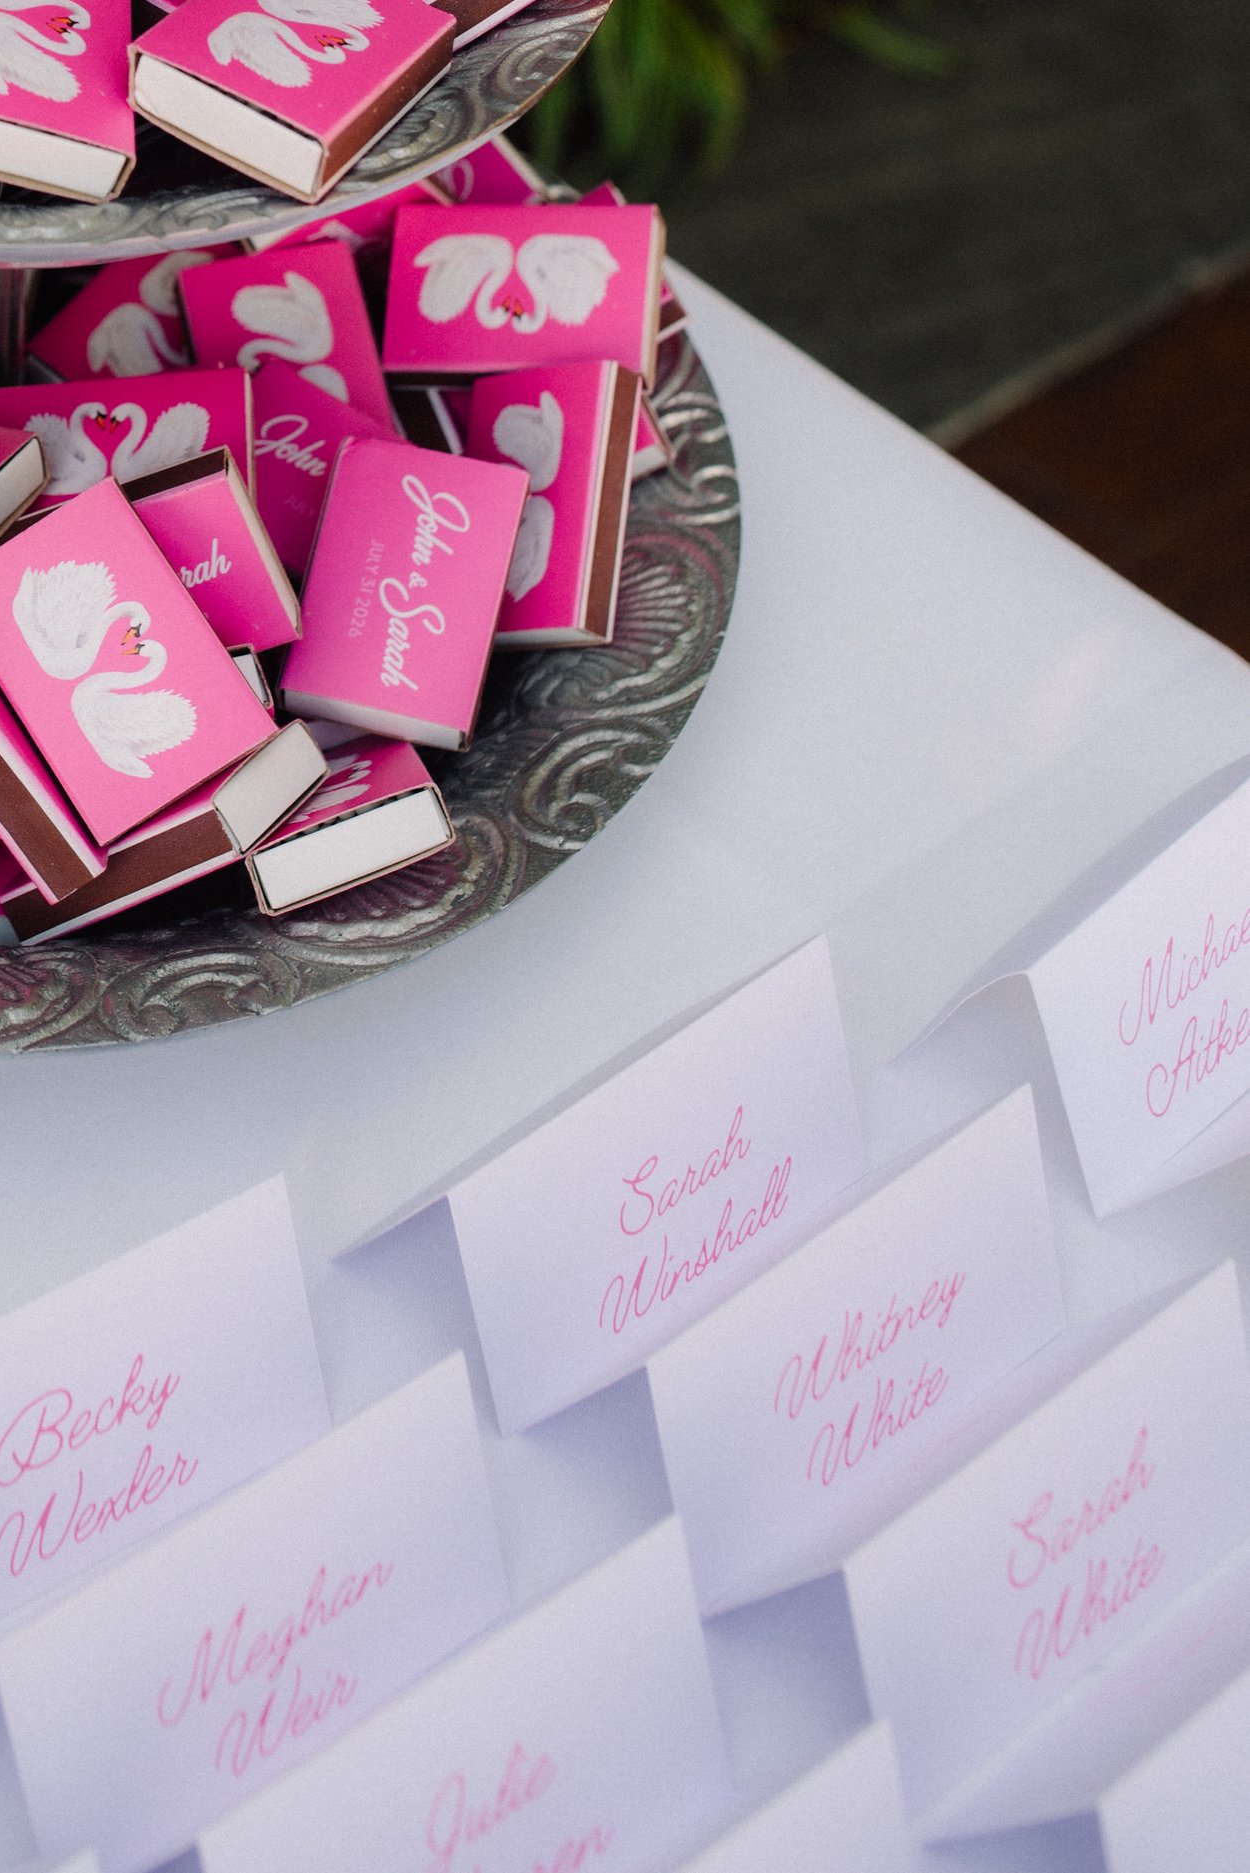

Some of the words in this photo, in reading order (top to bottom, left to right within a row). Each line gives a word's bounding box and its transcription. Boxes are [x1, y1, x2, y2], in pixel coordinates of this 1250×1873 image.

[254, 413, 328, 477] John
[401, 474, 471, 566] John
[408, 571, 428, 589] &
[348, 596, 372, 639] 2026
[378, 577, 446, 692] Sarah
[619, 1104, 752, 1235] Sarah
[599, 1155, 793, 1334] Winshall
[772, 1270, 967, 1420] Whitney
[806, 1358, 951, 1488] White
[1006, 1424, 1157, 1591] Sarah
[155, 1552, 398, 1728] Meghan
[1013, 1536, 1167, 1682] White
[213, 1665, 360, 1779] Weir
[421, 1739, 558, 1873] Julie
